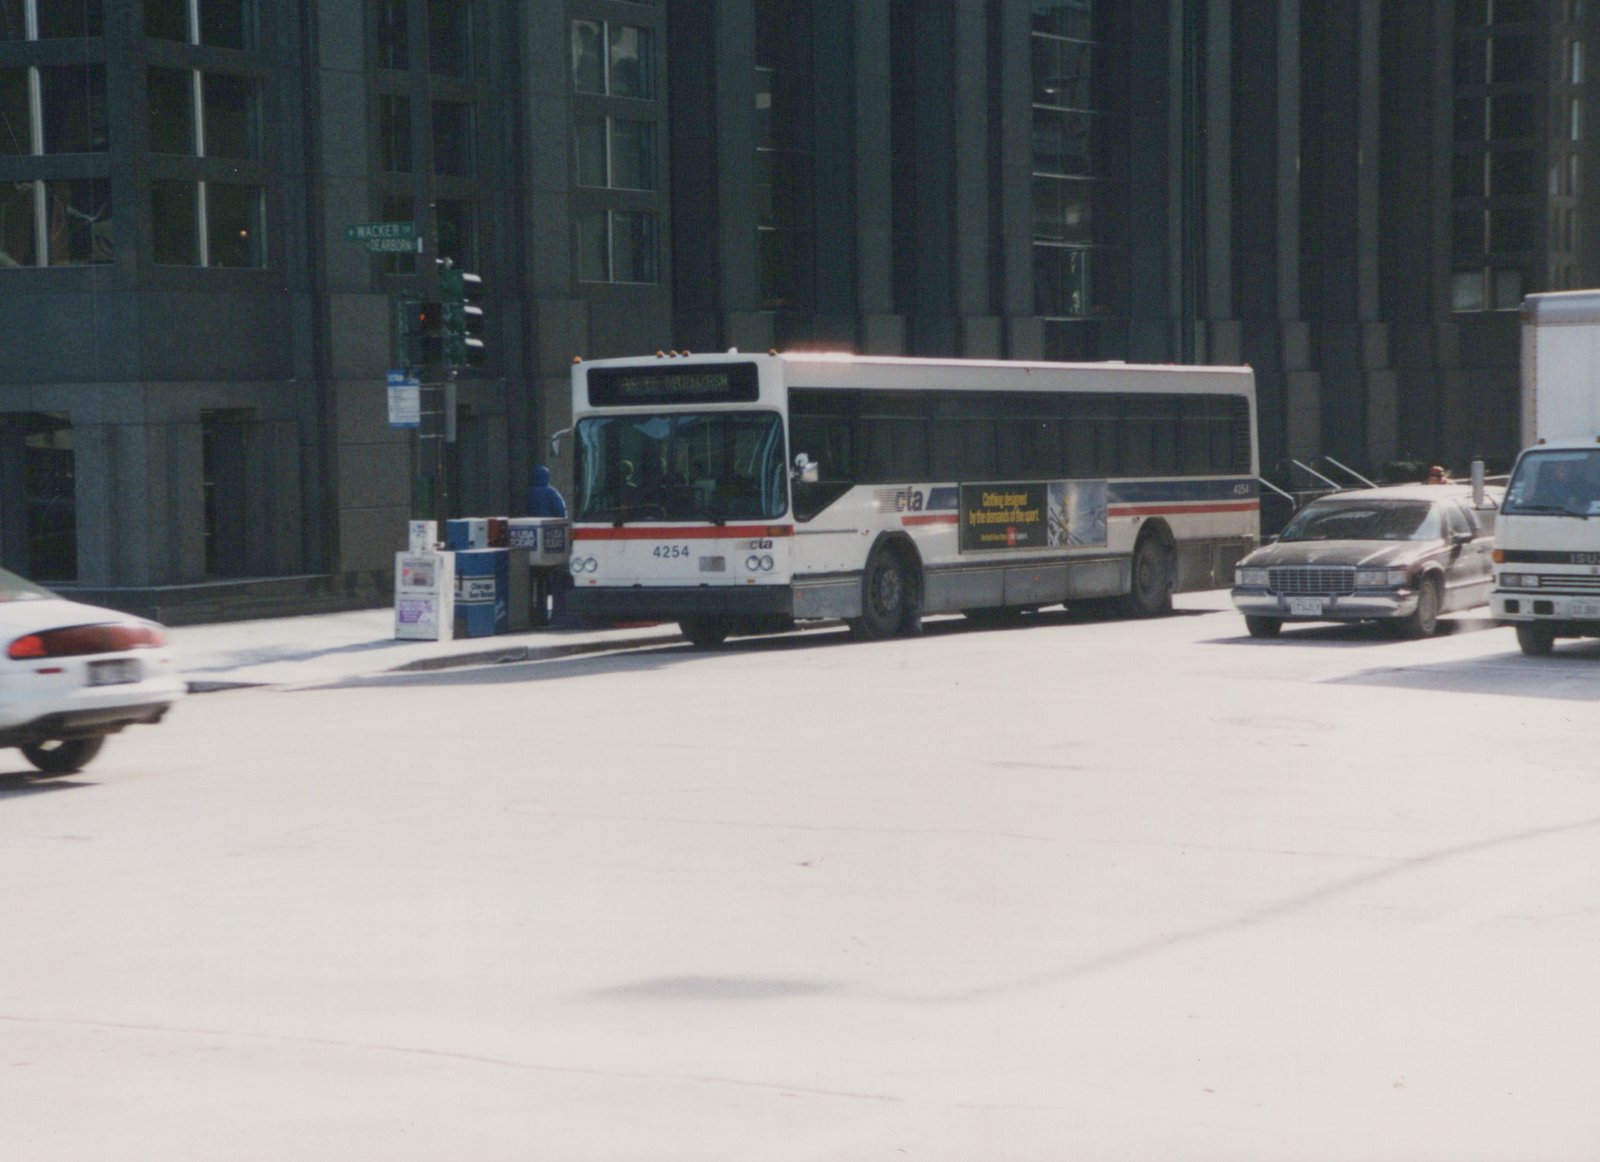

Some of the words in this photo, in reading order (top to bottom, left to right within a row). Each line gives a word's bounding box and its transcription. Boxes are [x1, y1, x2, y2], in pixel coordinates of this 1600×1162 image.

[357, 224, 399, 238] WACKER
[370, 238, 412, 252] DEARBORN
[895, 486, 923, 512] cta
[983, 492, 1004, 509] Clothing
[1004, 491, 1027, 509] designed
[517, 530, 535, 539] USA
[510, 539, 535, 548] TODAY
[750, 538, 773, 550] cta
[653, 545, 689, 558] 4254
[1570, 553, 1600, 564] ISU
